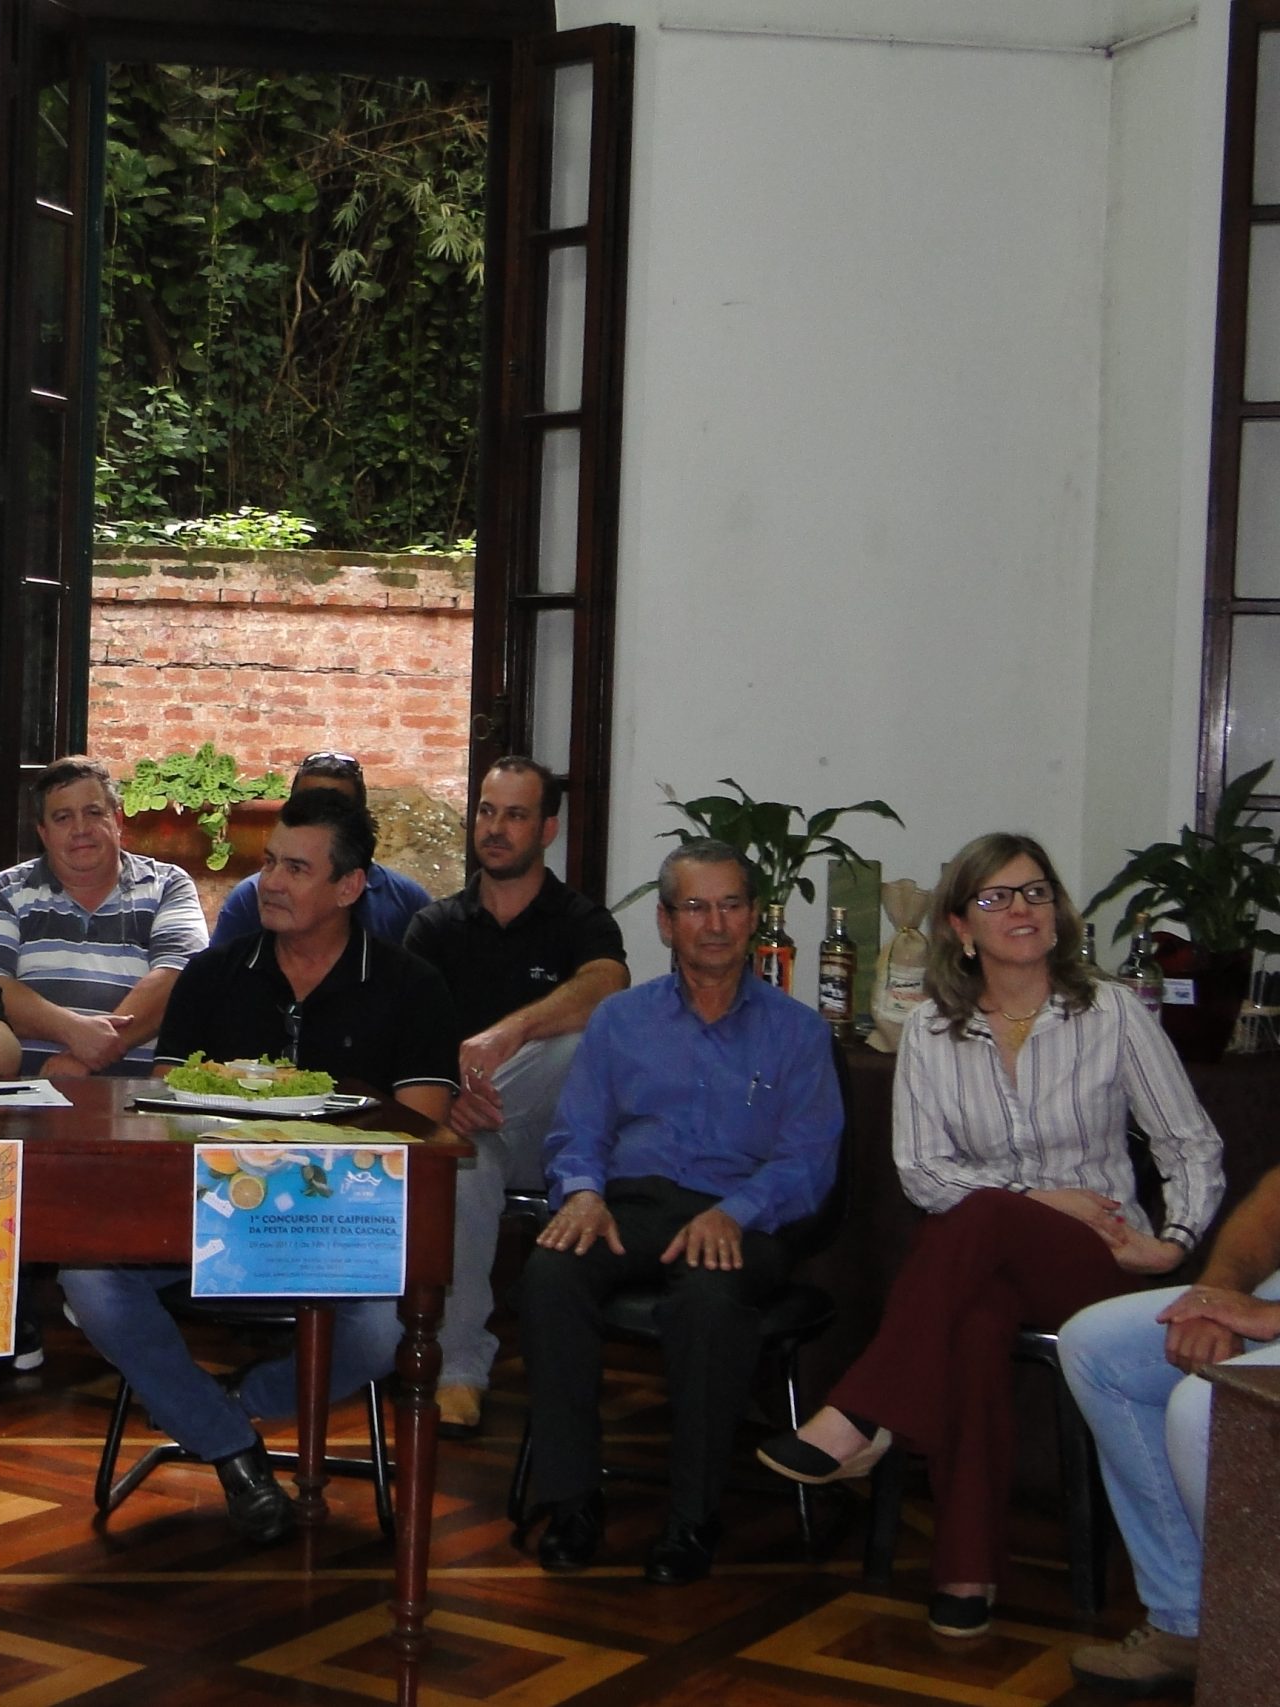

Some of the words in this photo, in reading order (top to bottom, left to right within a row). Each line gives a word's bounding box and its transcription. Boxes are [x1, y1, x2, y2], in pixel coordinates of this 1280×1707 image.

[262, 1215, 319, 1224] CONCURSO
[321, 1215, 335, 1224] DE
[337, 1215, 397, 1224] CAIPIRINHA
[249, 1226, 261, 1234] DA
[263, 1226, 288, 1234] FESTA
[291, 1226, 304, 1234] DO
[340, 1227, 353, 1235] DA
[355, 1227, 397, 1236] CACHAÇA
